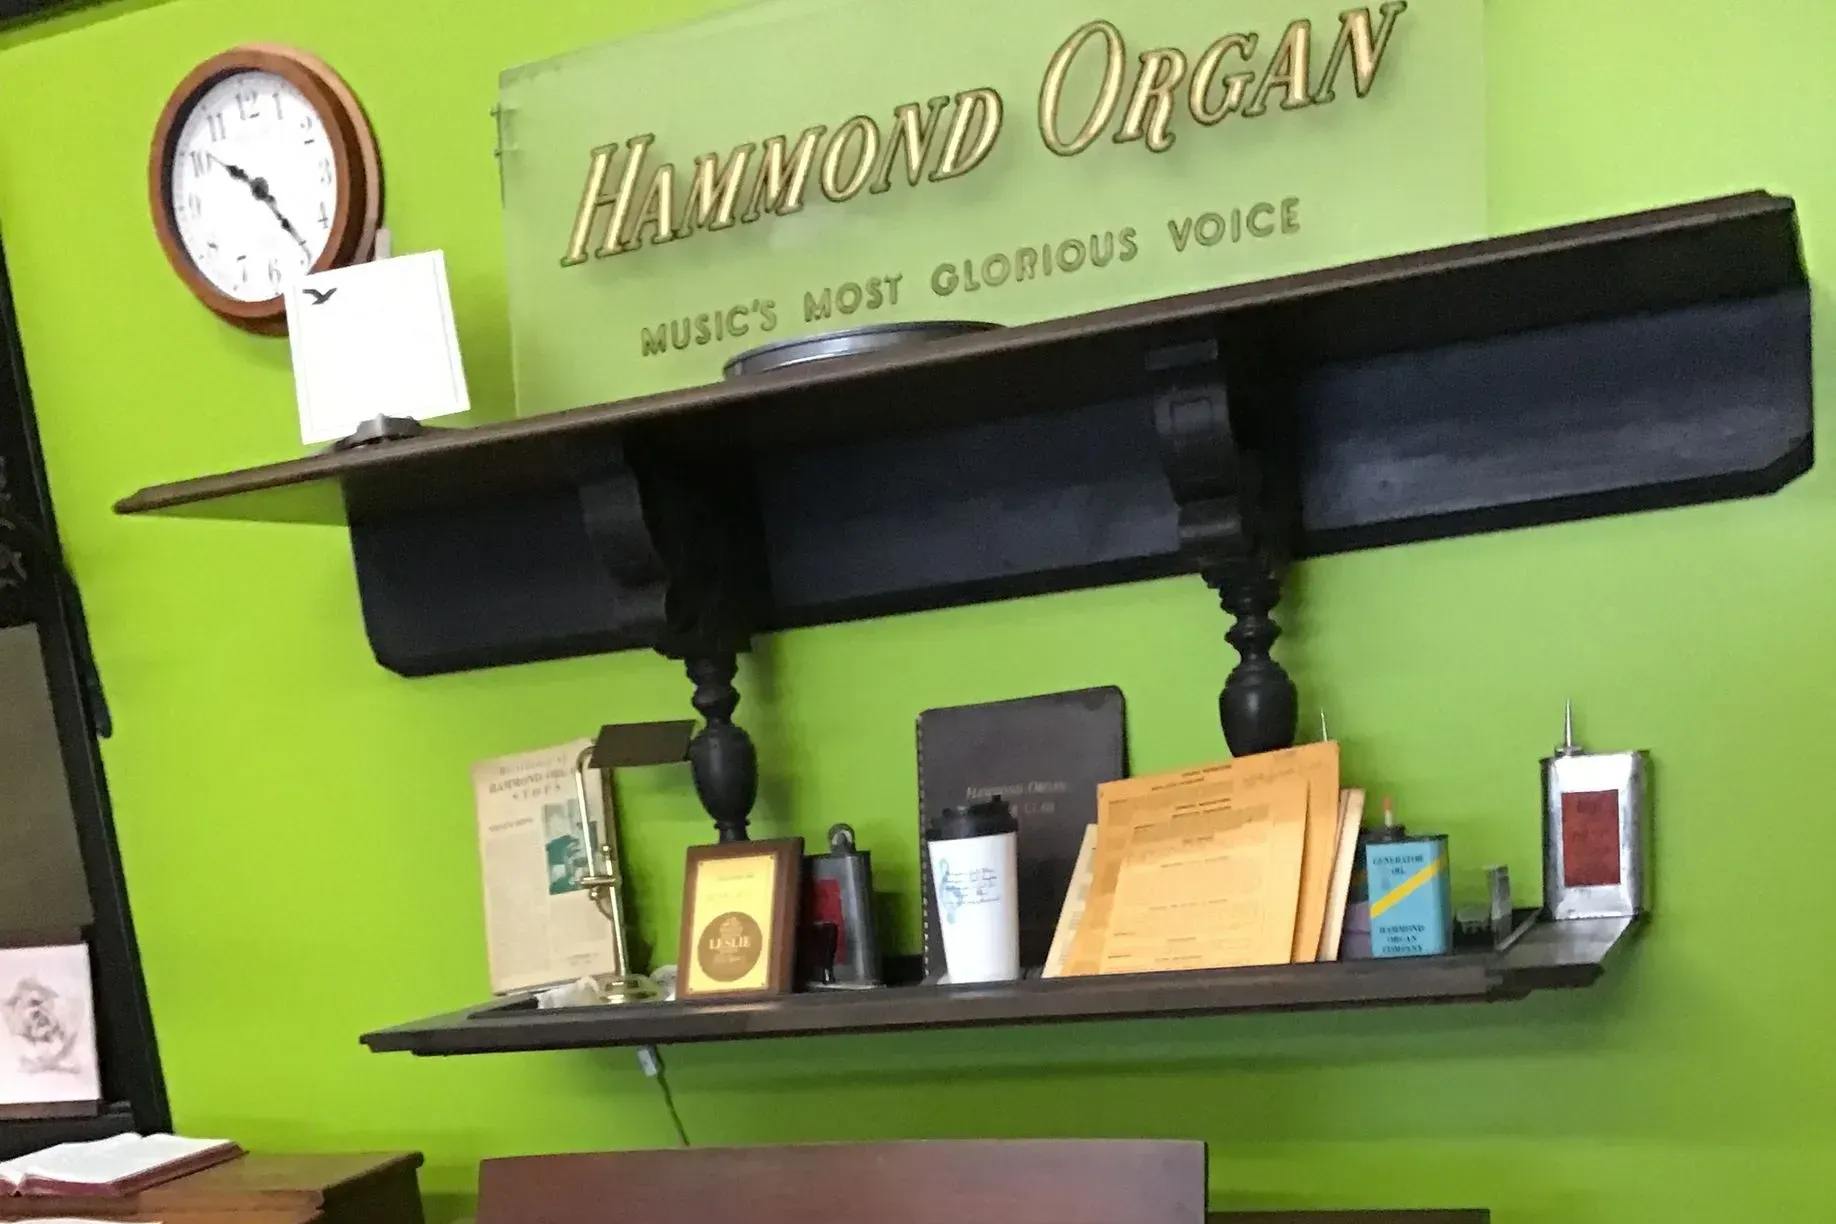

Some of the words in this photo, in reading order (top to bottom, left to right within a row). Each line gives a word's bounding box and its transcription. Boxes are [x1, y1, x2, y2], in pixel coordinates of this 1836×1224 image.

[561, 87, 1003, 268] HAMMOND
[1037, 2, 1404, 158] ORGAN
[640, 299, 780, 359] MUSIC'S
[803, 273, 904, 324] MOST
[929, 227, 1140, 299] GLORIOUS
[1167, 197, 1303, 251] VOICE
